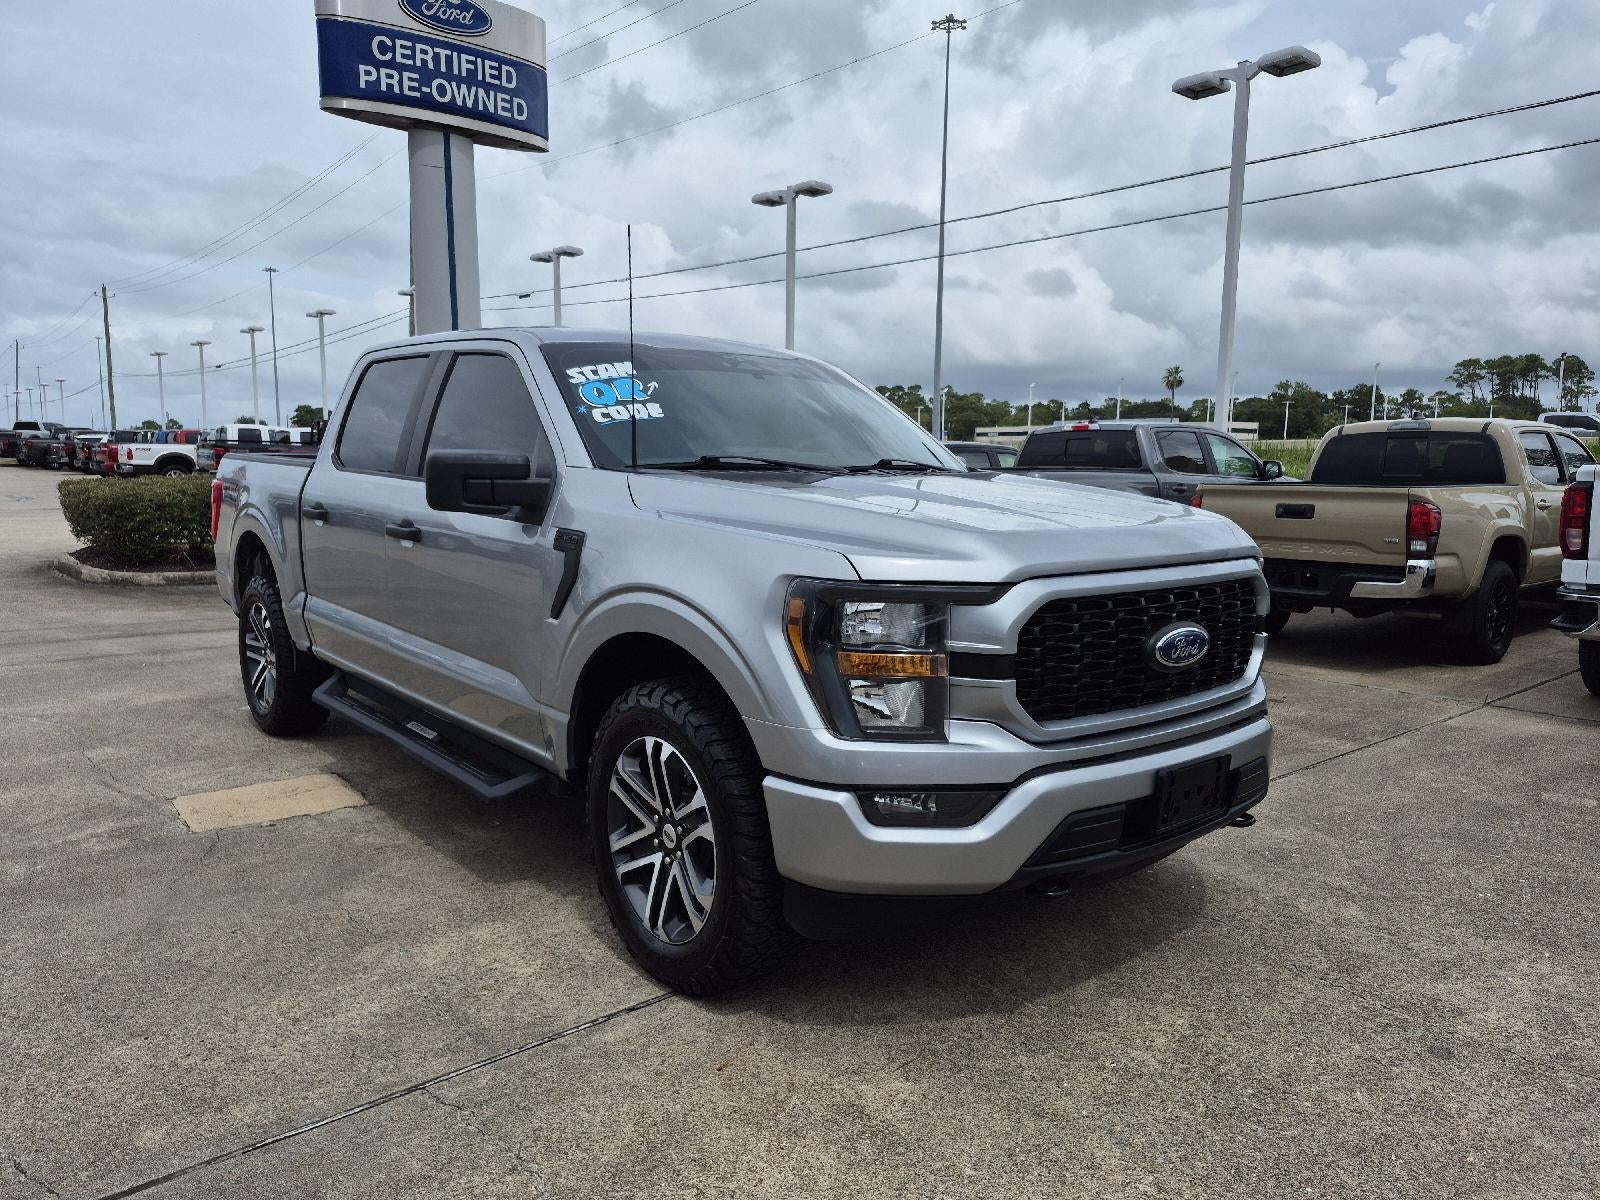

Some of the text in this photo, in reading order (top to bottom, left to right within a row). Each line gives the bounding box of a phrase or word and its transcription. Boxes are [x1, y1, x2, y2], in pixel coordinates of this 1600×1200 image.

[421, 0, 474, 25] Ford
[371, 35, 518, 90] CERTIFIED
[358, 64, 529, 122] PRE-OWNED
[566, 361, 638, 384] SCAN
[592, 402, 665, 424] CODE
[1171, 635, 1200, 659] Ford
